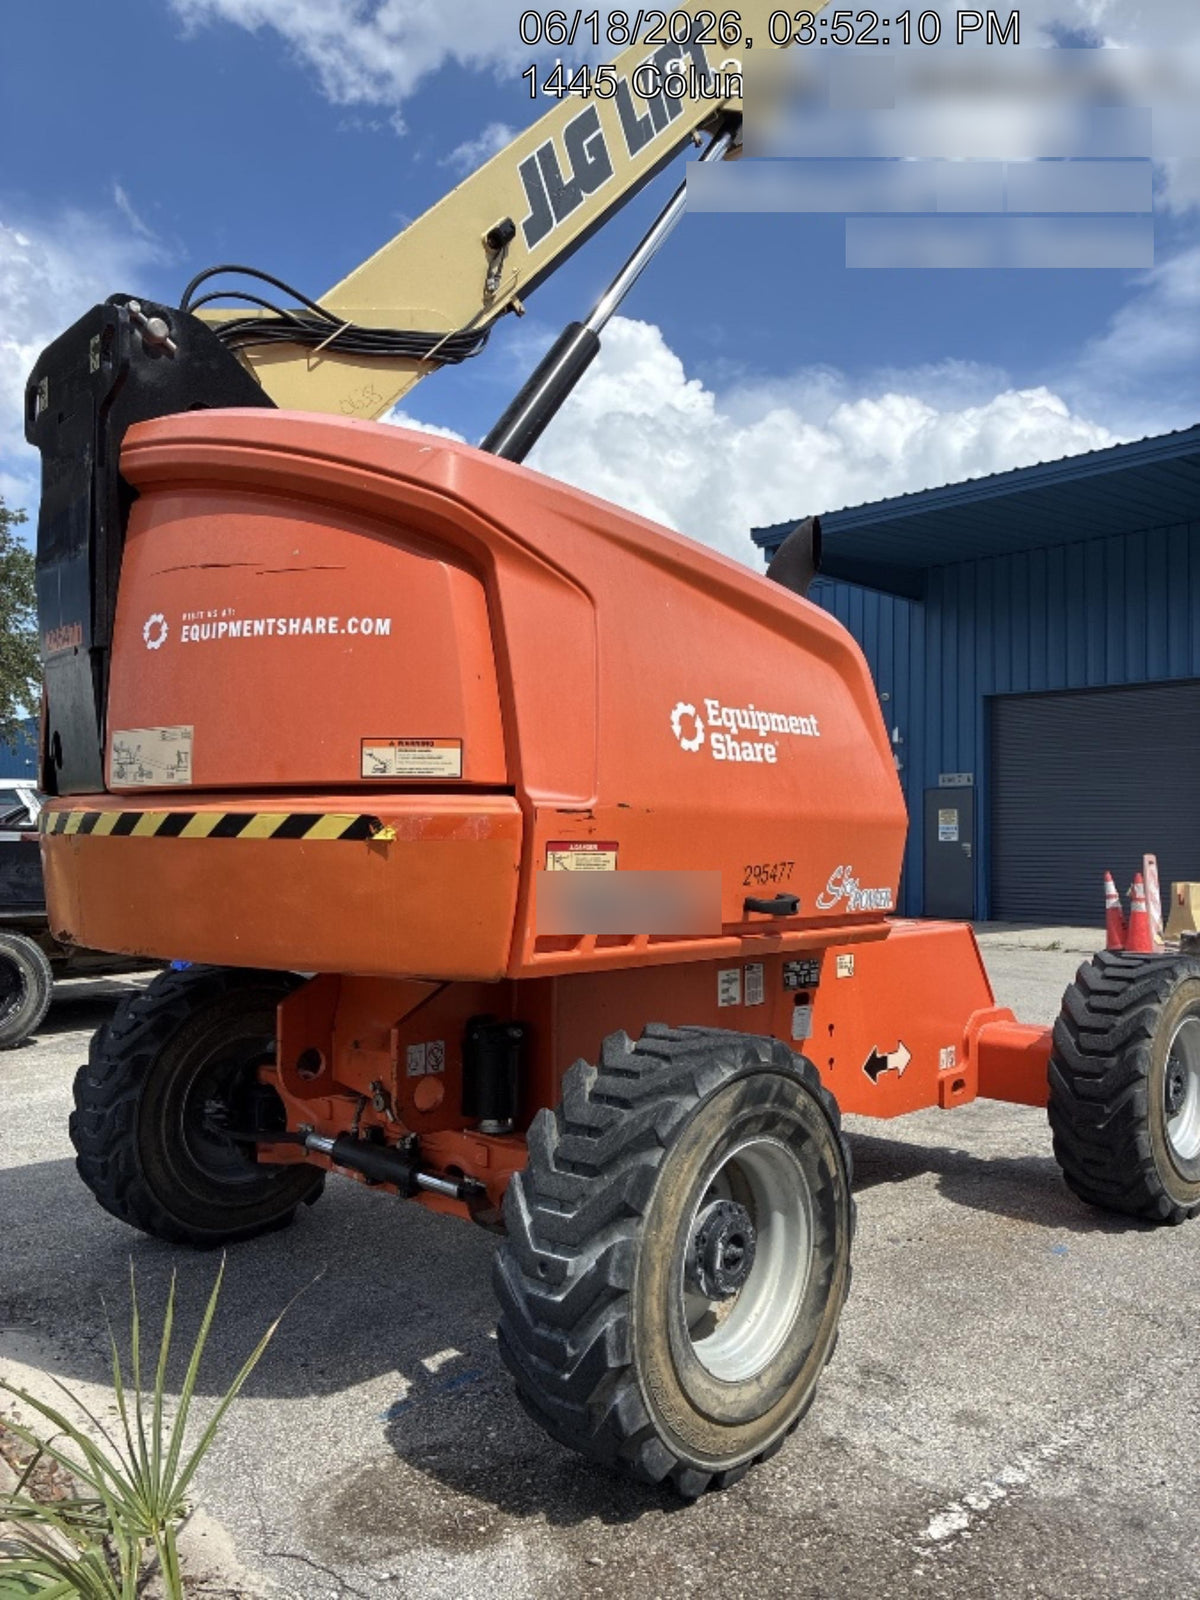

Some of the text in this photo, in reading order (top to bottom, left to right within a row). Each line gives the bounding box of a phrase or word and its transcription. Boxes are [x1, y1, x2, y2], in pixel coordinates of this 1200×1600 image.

[518, 101, 616, 251] JLG
[615, 18, 714, 159] LIFT
[180, 616, 392, 643] EQUIPMENTSHARE.COM
[704, 698, 820, 737] Equipment
[710, 734, 778, 764] Share
[742, 861, 795, 887] 295477
